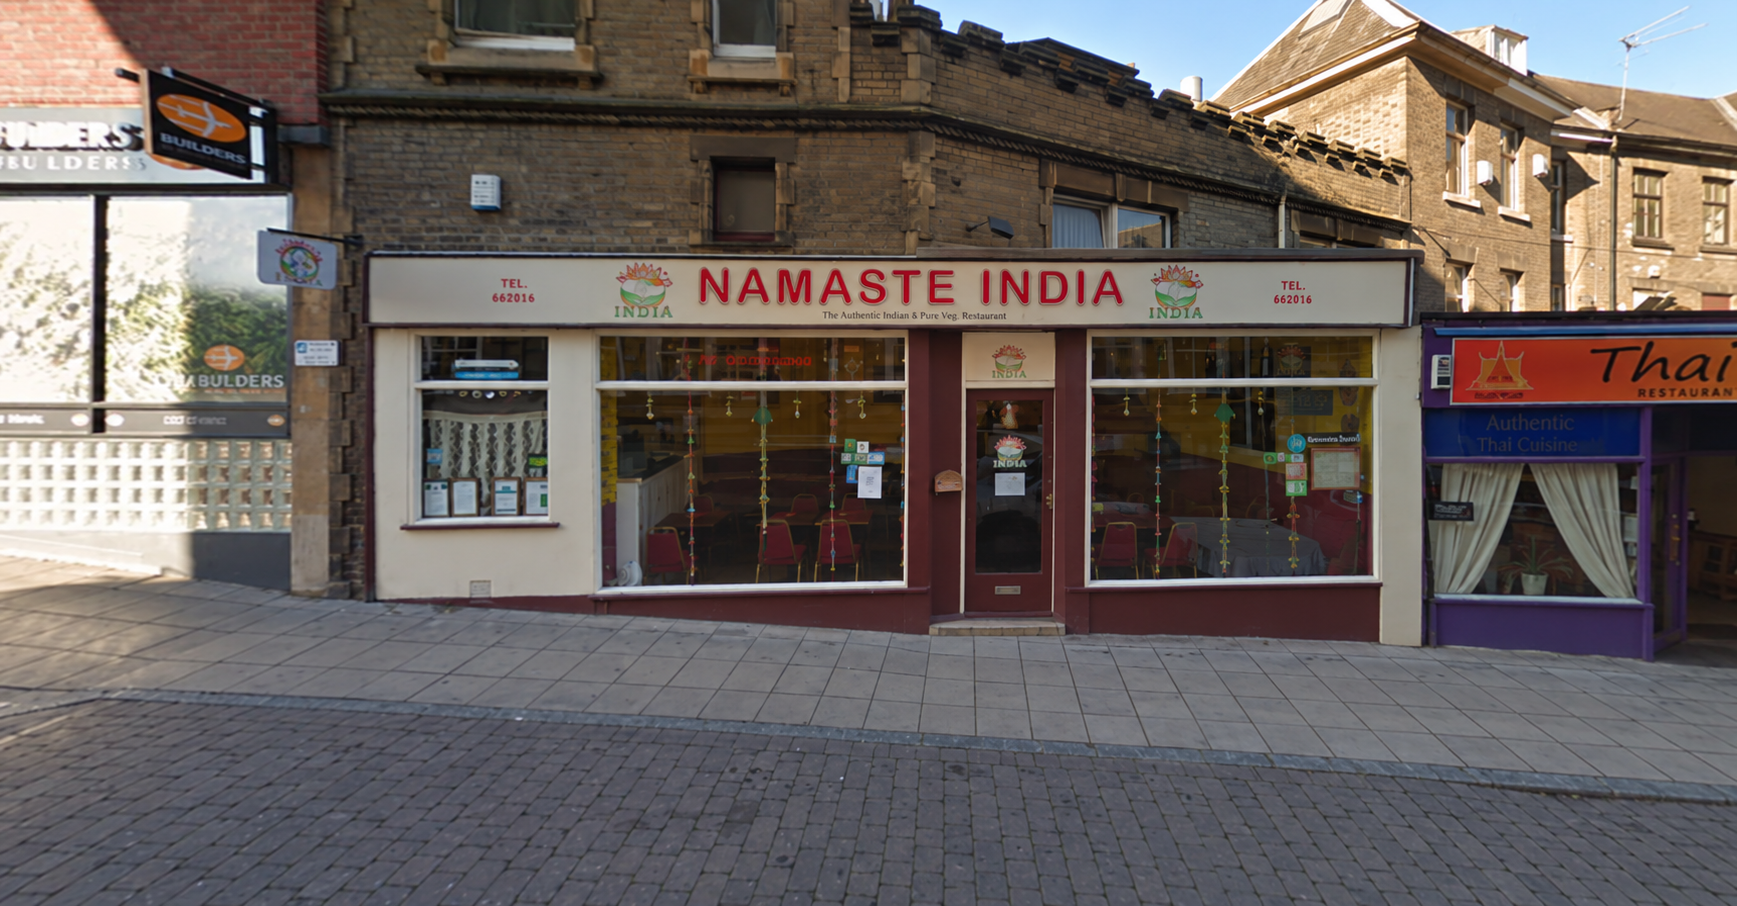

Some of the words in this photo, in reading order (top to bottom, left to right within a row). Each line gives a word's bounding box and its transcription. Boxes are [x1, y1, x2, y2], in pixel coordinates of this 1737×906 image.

[160, 133, 246, 164] BUILDERS
[501, 278, 528, 289] TEL.
[699, 266, 956, 306] NAMASTE
[980, 268, 1125, 306] INDIA
[1281, 281, 1306, 291] TEL.
[492, 293, 535, 303] 662016
[1273, 295, 1312, 304] 662016
[614, 305, 674, 318] INDIA
[822, 311, 839, 320] The
[840, 311, 881, 320] Authentic
[883, 311, 910, 320] Indian
[911, 311, 918, 320] &
[920, 311, 940, 320] Pure
[941, 312, 960, 321] Veg.
[962, 311, 1007, 320] Restaurant
[1148, 307, 1204, 319] INDIA
[1590, 341, 1737, 383] Thai
[992, 370, 1027, 379] INDIA
[198, 374, 285, 388] BULDERS
[1637, 388, 1737, 398] RESTAURAN
[1486, 413, 1575, 431] Authentic
[1476, 436, 1512, 452] Thai
[1517, 436, 1578, 452] Cuisine
[993, 460, 1028, 469] INDIA
